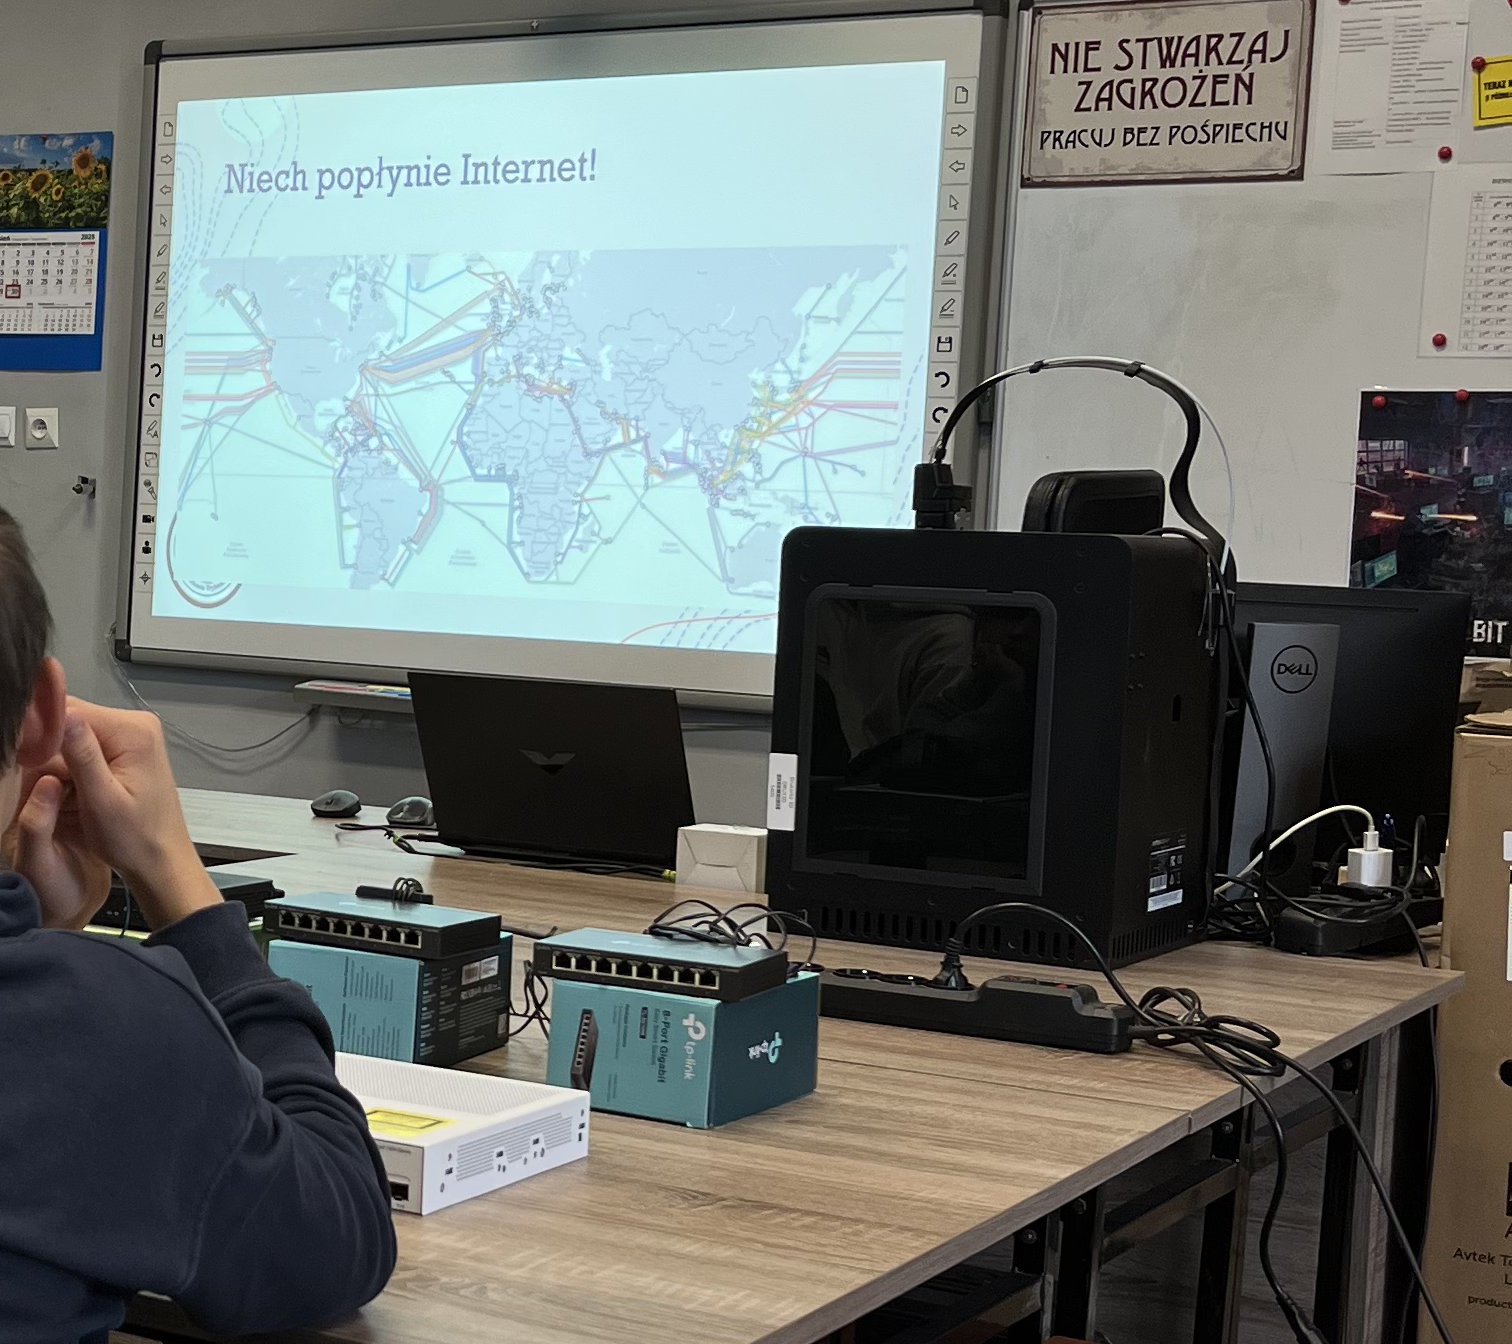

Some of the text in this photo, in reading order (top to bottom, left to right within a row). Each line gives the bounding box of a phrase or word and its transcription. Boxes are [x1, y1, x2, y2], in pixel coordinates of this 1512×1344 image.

[1049, 28, 1291, 74] NIE STWARZAJ
[1074, 64, 1256, 113] ZAGROŻEŃ
[1039, 119, 1289, 150] PRACUJ BEZ POŚPIECHU
[224, 148, 597, 199] Niech popłynie Internet!
[1473, 620, 1509, 643] BIT
[1277, 663, 1313, 675] DELL
[657, 1009, 671, 1083] 8-Port Gigabit
[683, 1041, 696, 1080] tp-link
[1453, 1247, 1495, 1265] Avtek
